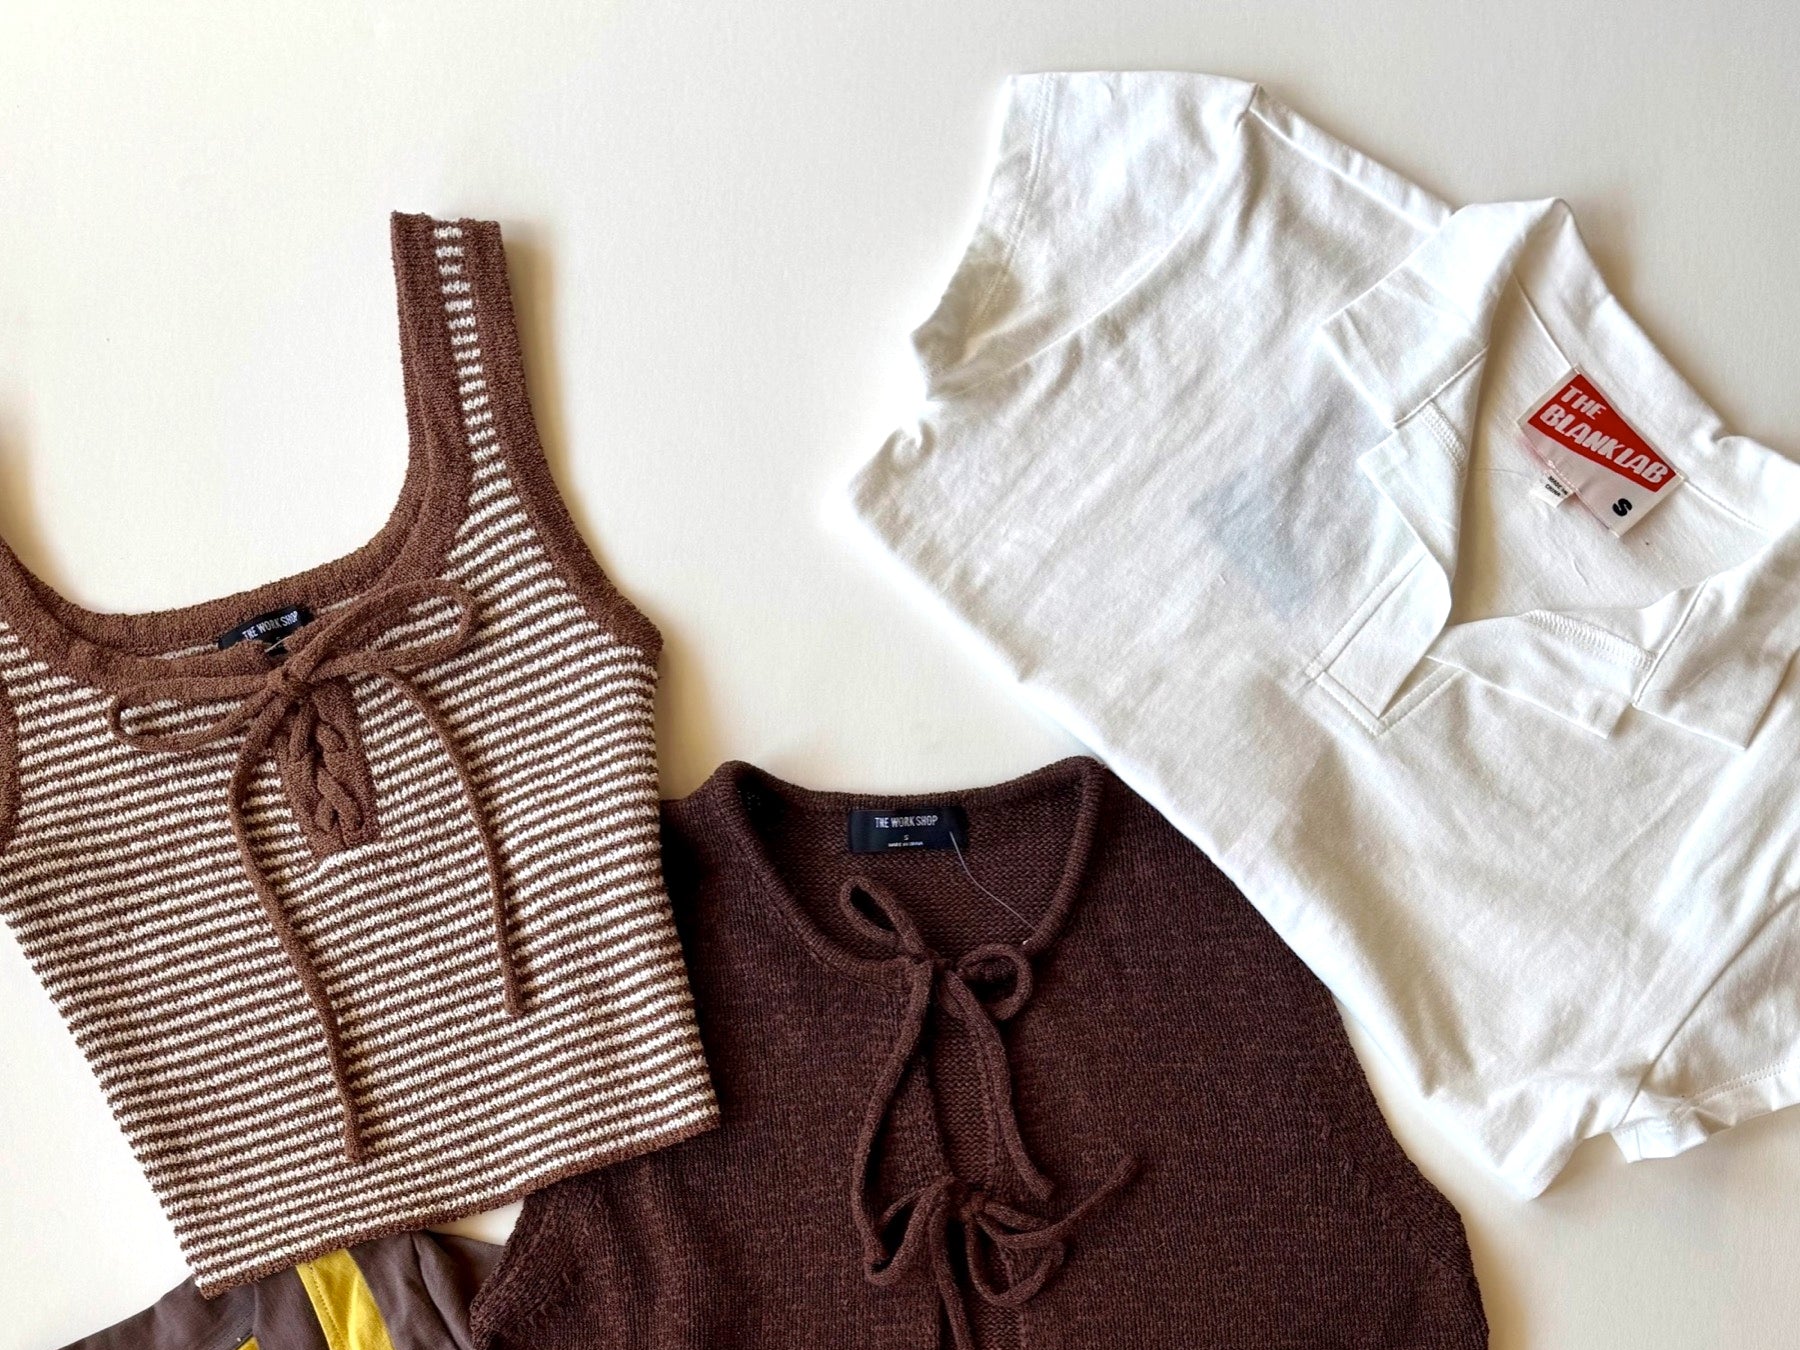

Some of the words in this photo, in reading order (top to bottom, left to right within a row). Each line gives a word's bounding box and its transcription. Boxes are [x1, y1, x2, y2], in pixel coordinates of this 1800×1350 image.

[1560, 385, 1607, 420] THE
[1612, 498, 1633, 517] S
[241, 626, 259, 641] THE
[256, 618, 282, 634] WORK
[280, 610, 299, 627] SHOP
[874, 817, 889, 828] THE
[890, 816, 915, 828] WORK
[915, 815, 938, 826] SHOP
